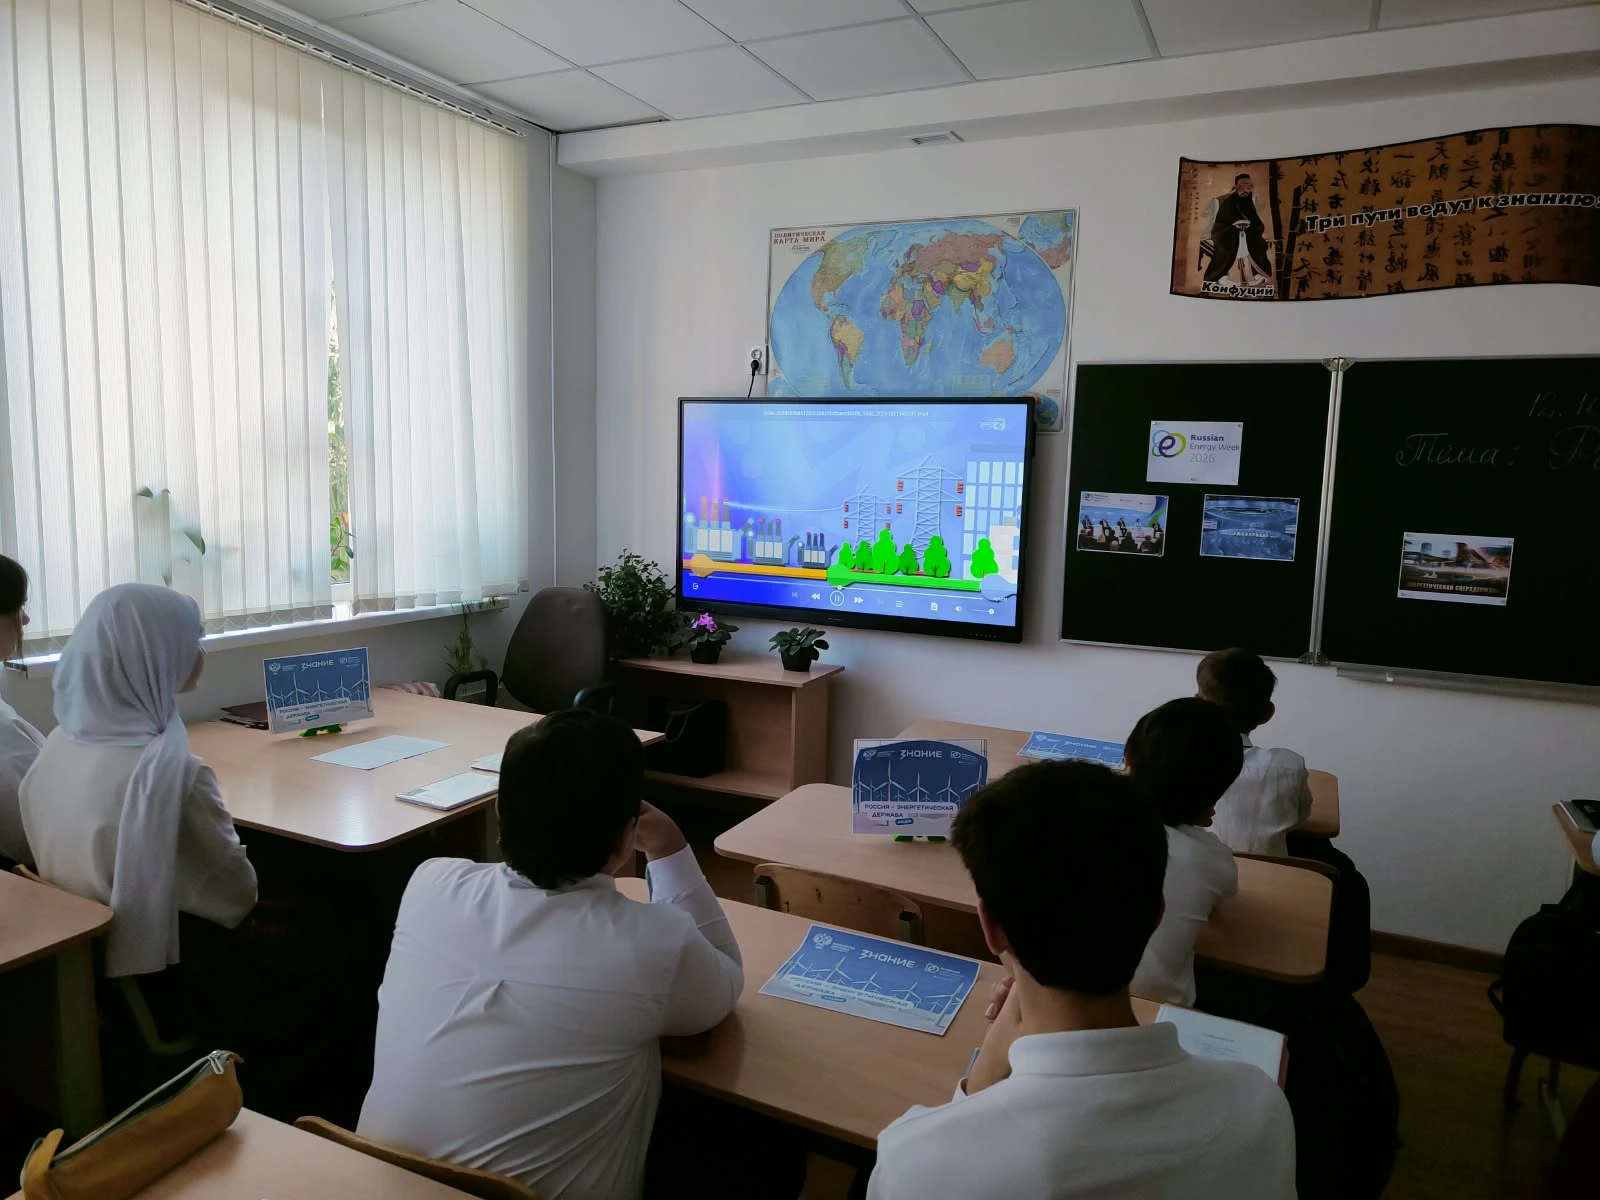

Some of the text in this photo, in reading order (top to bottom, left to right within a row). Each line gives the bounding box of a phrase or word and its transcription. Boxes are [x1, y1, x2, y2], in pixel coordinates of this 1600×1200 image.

[1305, 214, 1346, 233] Три
[1350, 207, 1402, 228] пути
[1406, 194, 1474, 219] ведут
[1477, 194, 1495, 209] к
[773, 235, 826, 245] КАРТА МИРА
[1201, 281, 1274, 298] Конфуций
[1190, 433, 1224, 442] Russian
[1189, 442, 1240, 451] Energy Week
[899, 749, 944, 760] ЗНАНИЕ
[864, 803, 890, 811] РОССИЯ
[896, 804, 954, 812] ЭНЕРГЕТИЧЕСКАЯ
[858, 949, 917, 969] ЗНАНИЕ
